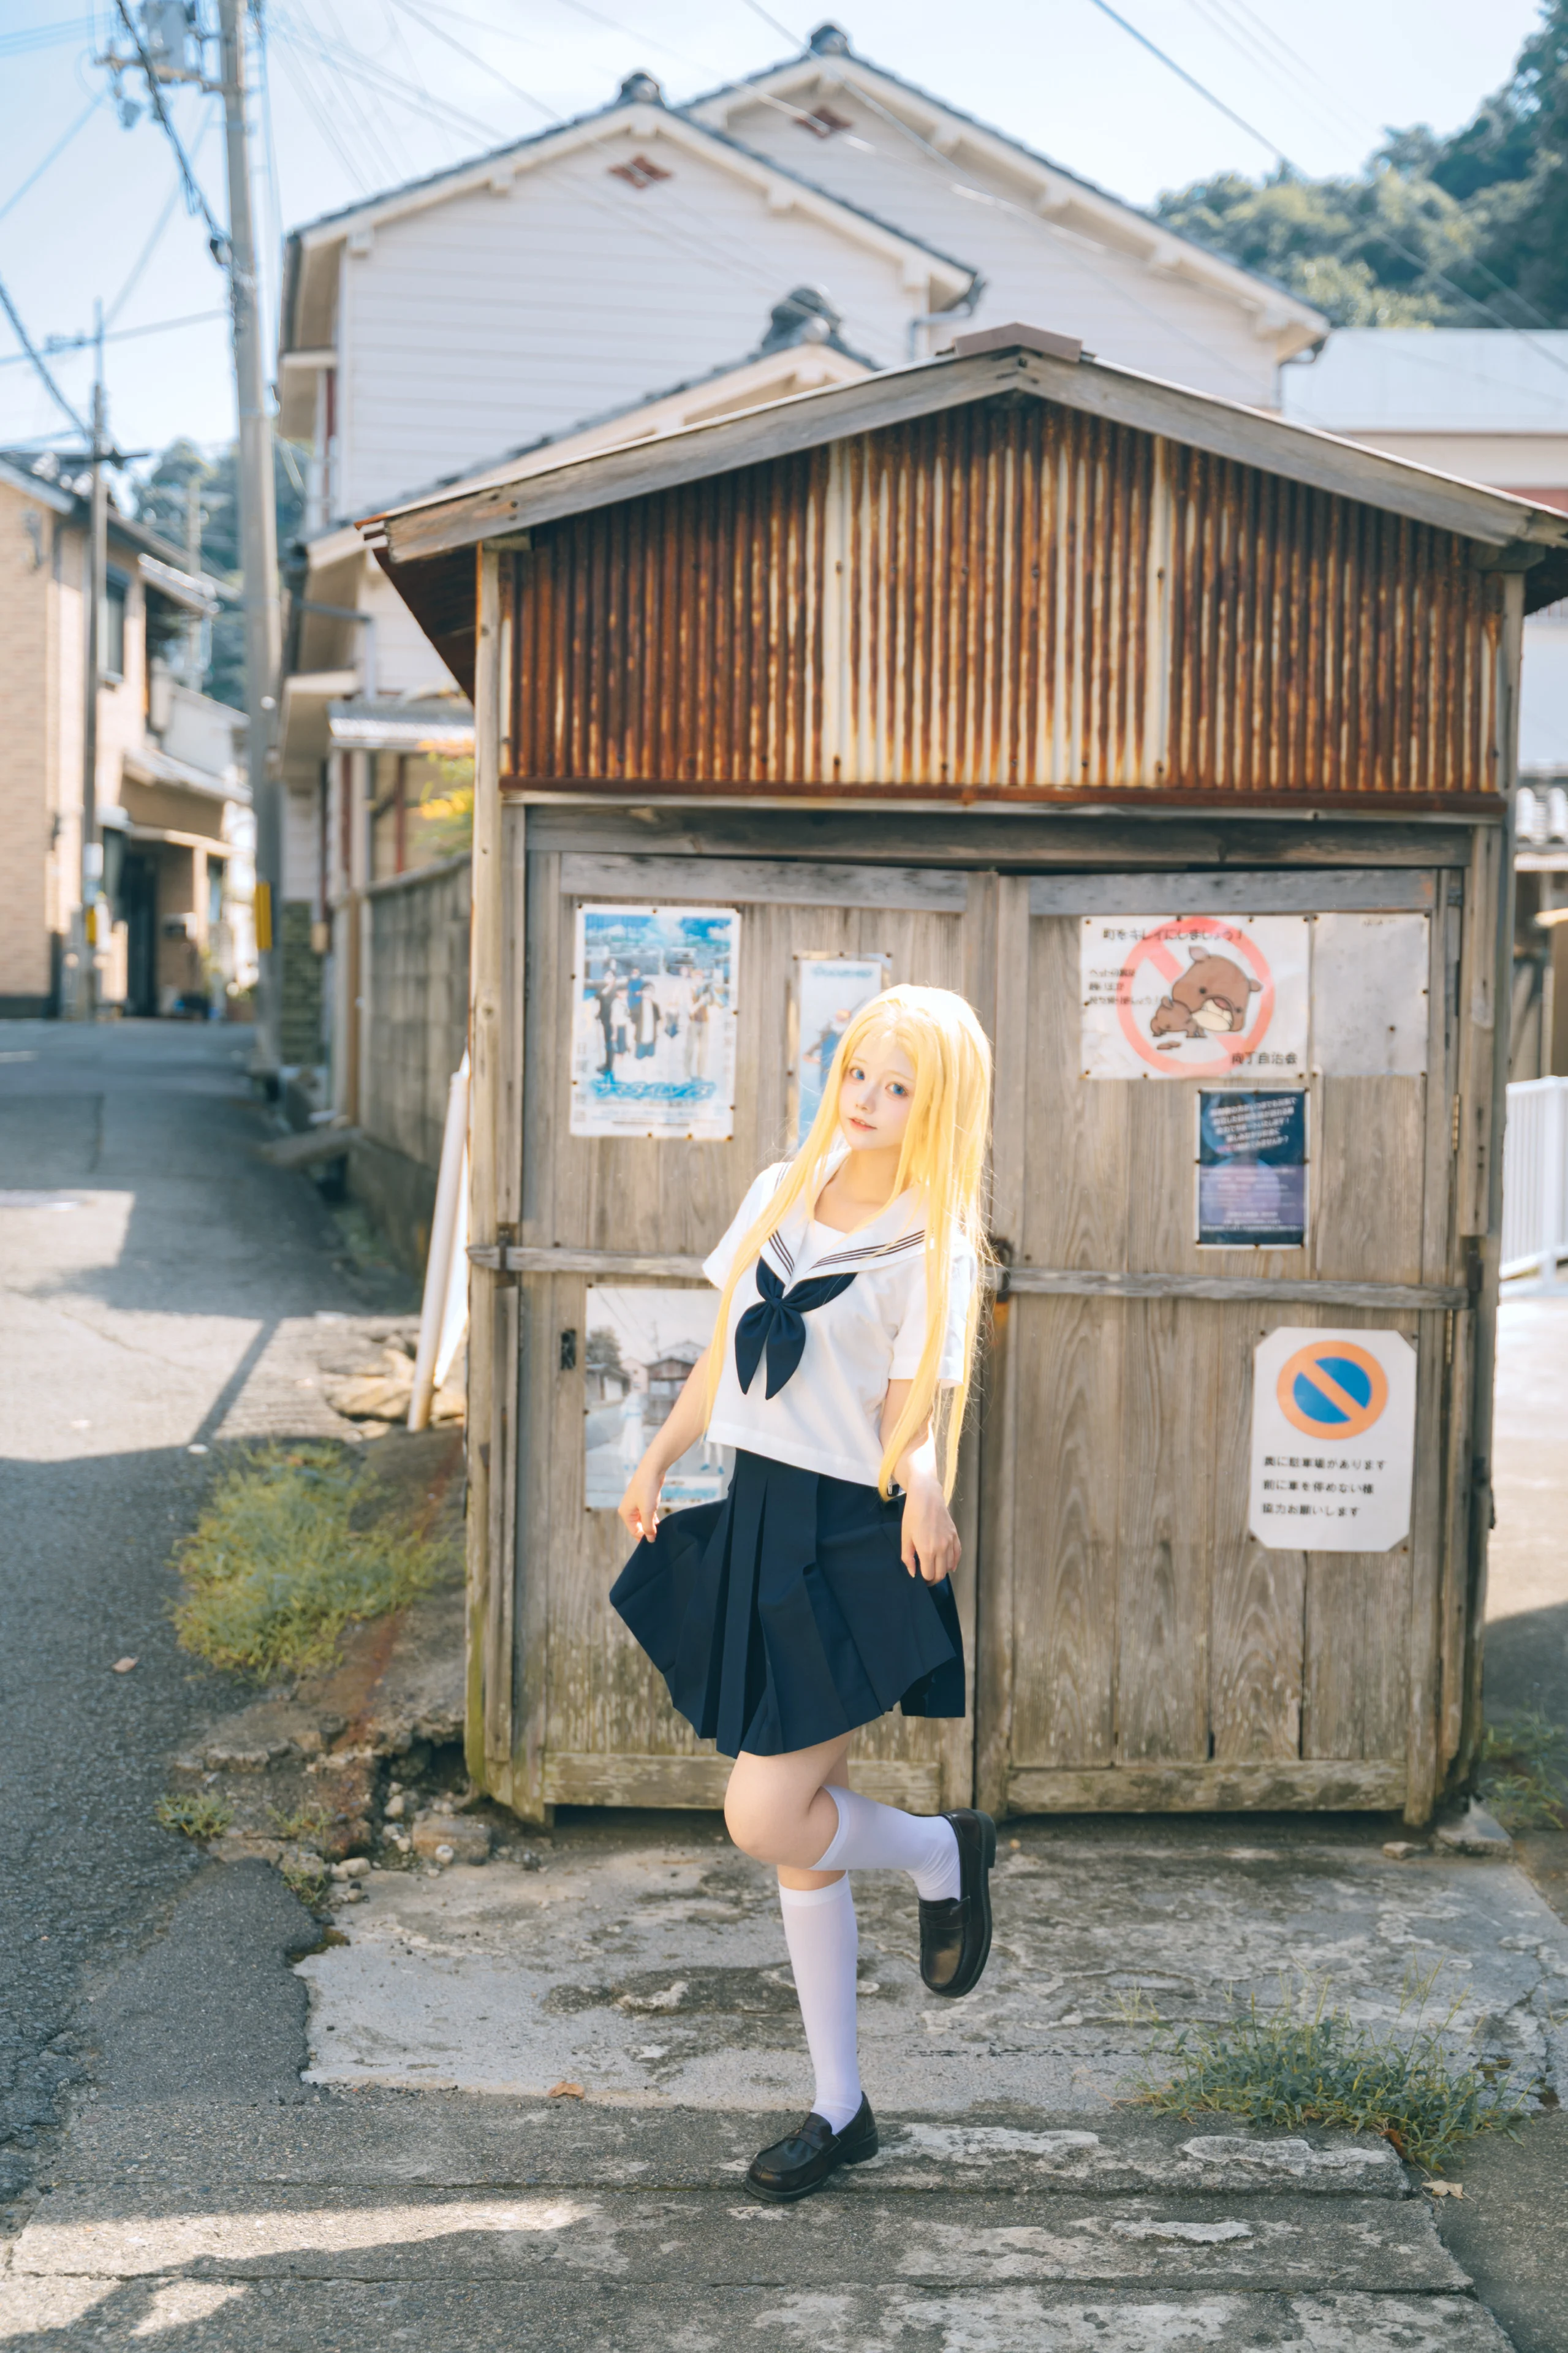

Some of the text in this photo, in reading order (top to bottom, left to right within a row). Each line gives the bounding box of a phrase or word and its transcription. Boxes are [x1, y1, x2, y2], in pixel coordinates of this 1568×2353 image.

[1262, 1502, 1360, 1517] 協力お願いします
